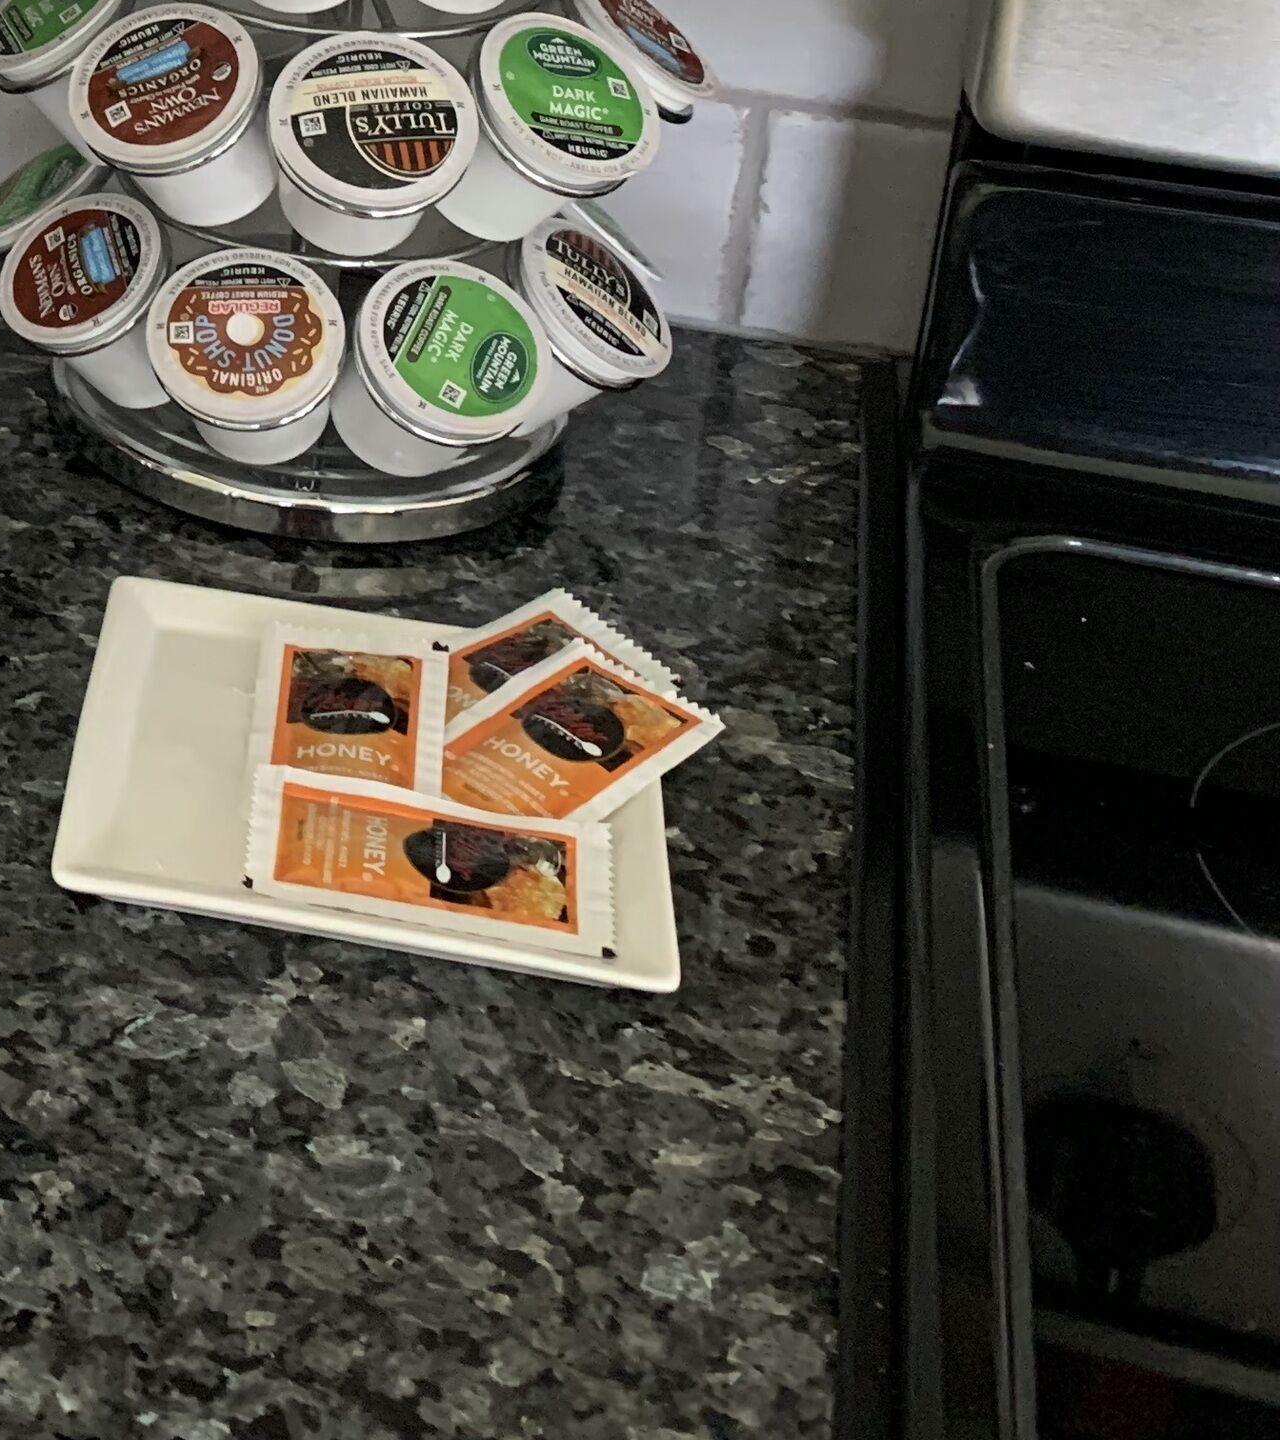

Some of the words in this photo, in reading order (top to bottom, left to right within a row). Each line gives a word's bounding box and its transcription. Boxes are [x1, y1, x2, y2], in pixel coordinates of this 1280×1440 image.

[119, 24, 159, 46] KEURIG
[335, 52, 382, 64] KEURIG
[533, 51, 596, 68] MOUNTAIN
[540, 43, 582, 57] GREEN
[118, 56, 202, 96] ORGANICS
[149, 85, 196, 111] OWN
[312, 91, 355, 107] BLEND
[361, 86, 427, 102] HAWAIIAN
[370, 101, 432, 112] COFFEE
[552, 85, 597, 102] DARK
[355, 110, 454, 137] TULLY'S
[549, 102, 603, 120] MAGIC
[568, 145, 608, 158] KEURIG
[69, 233, 92, 295] ORGANICS
[223, 267, 264, 275] KEURIG
[552, 235, 626, 297] TULLY'S
[51, 263, 66, 296] OWN
[564, 267, 617, 309] HAWAIIAN
[208, 300, 279, 313] REGULAR
[231, 291, 255, 299] ROAST
[437, 292, 447, 309] DARK
[386, 293, 410, 330] KEURIG
[425, 309, 440, 330] ROAST
[194, 314, 236, 368] SHOP
[241, 314, 295, 371] DONUT
[410, 329, 427, 355] COFFEE
[429, 309, 459, 353] MAGIC
[446, 321, 474, 362] DARK
[582, 316, 621, 347] KEURIG
[211, 368, 282, 385] ORIGINAL
[478, 337, 512, 393] MOUNTAIN
[494, 352, 518, 389] GREEN
[296, 743, 391, 766] HONEY
[482, 735, 569, 788] HONEY
[362, 815, 387, 877] HONEY
